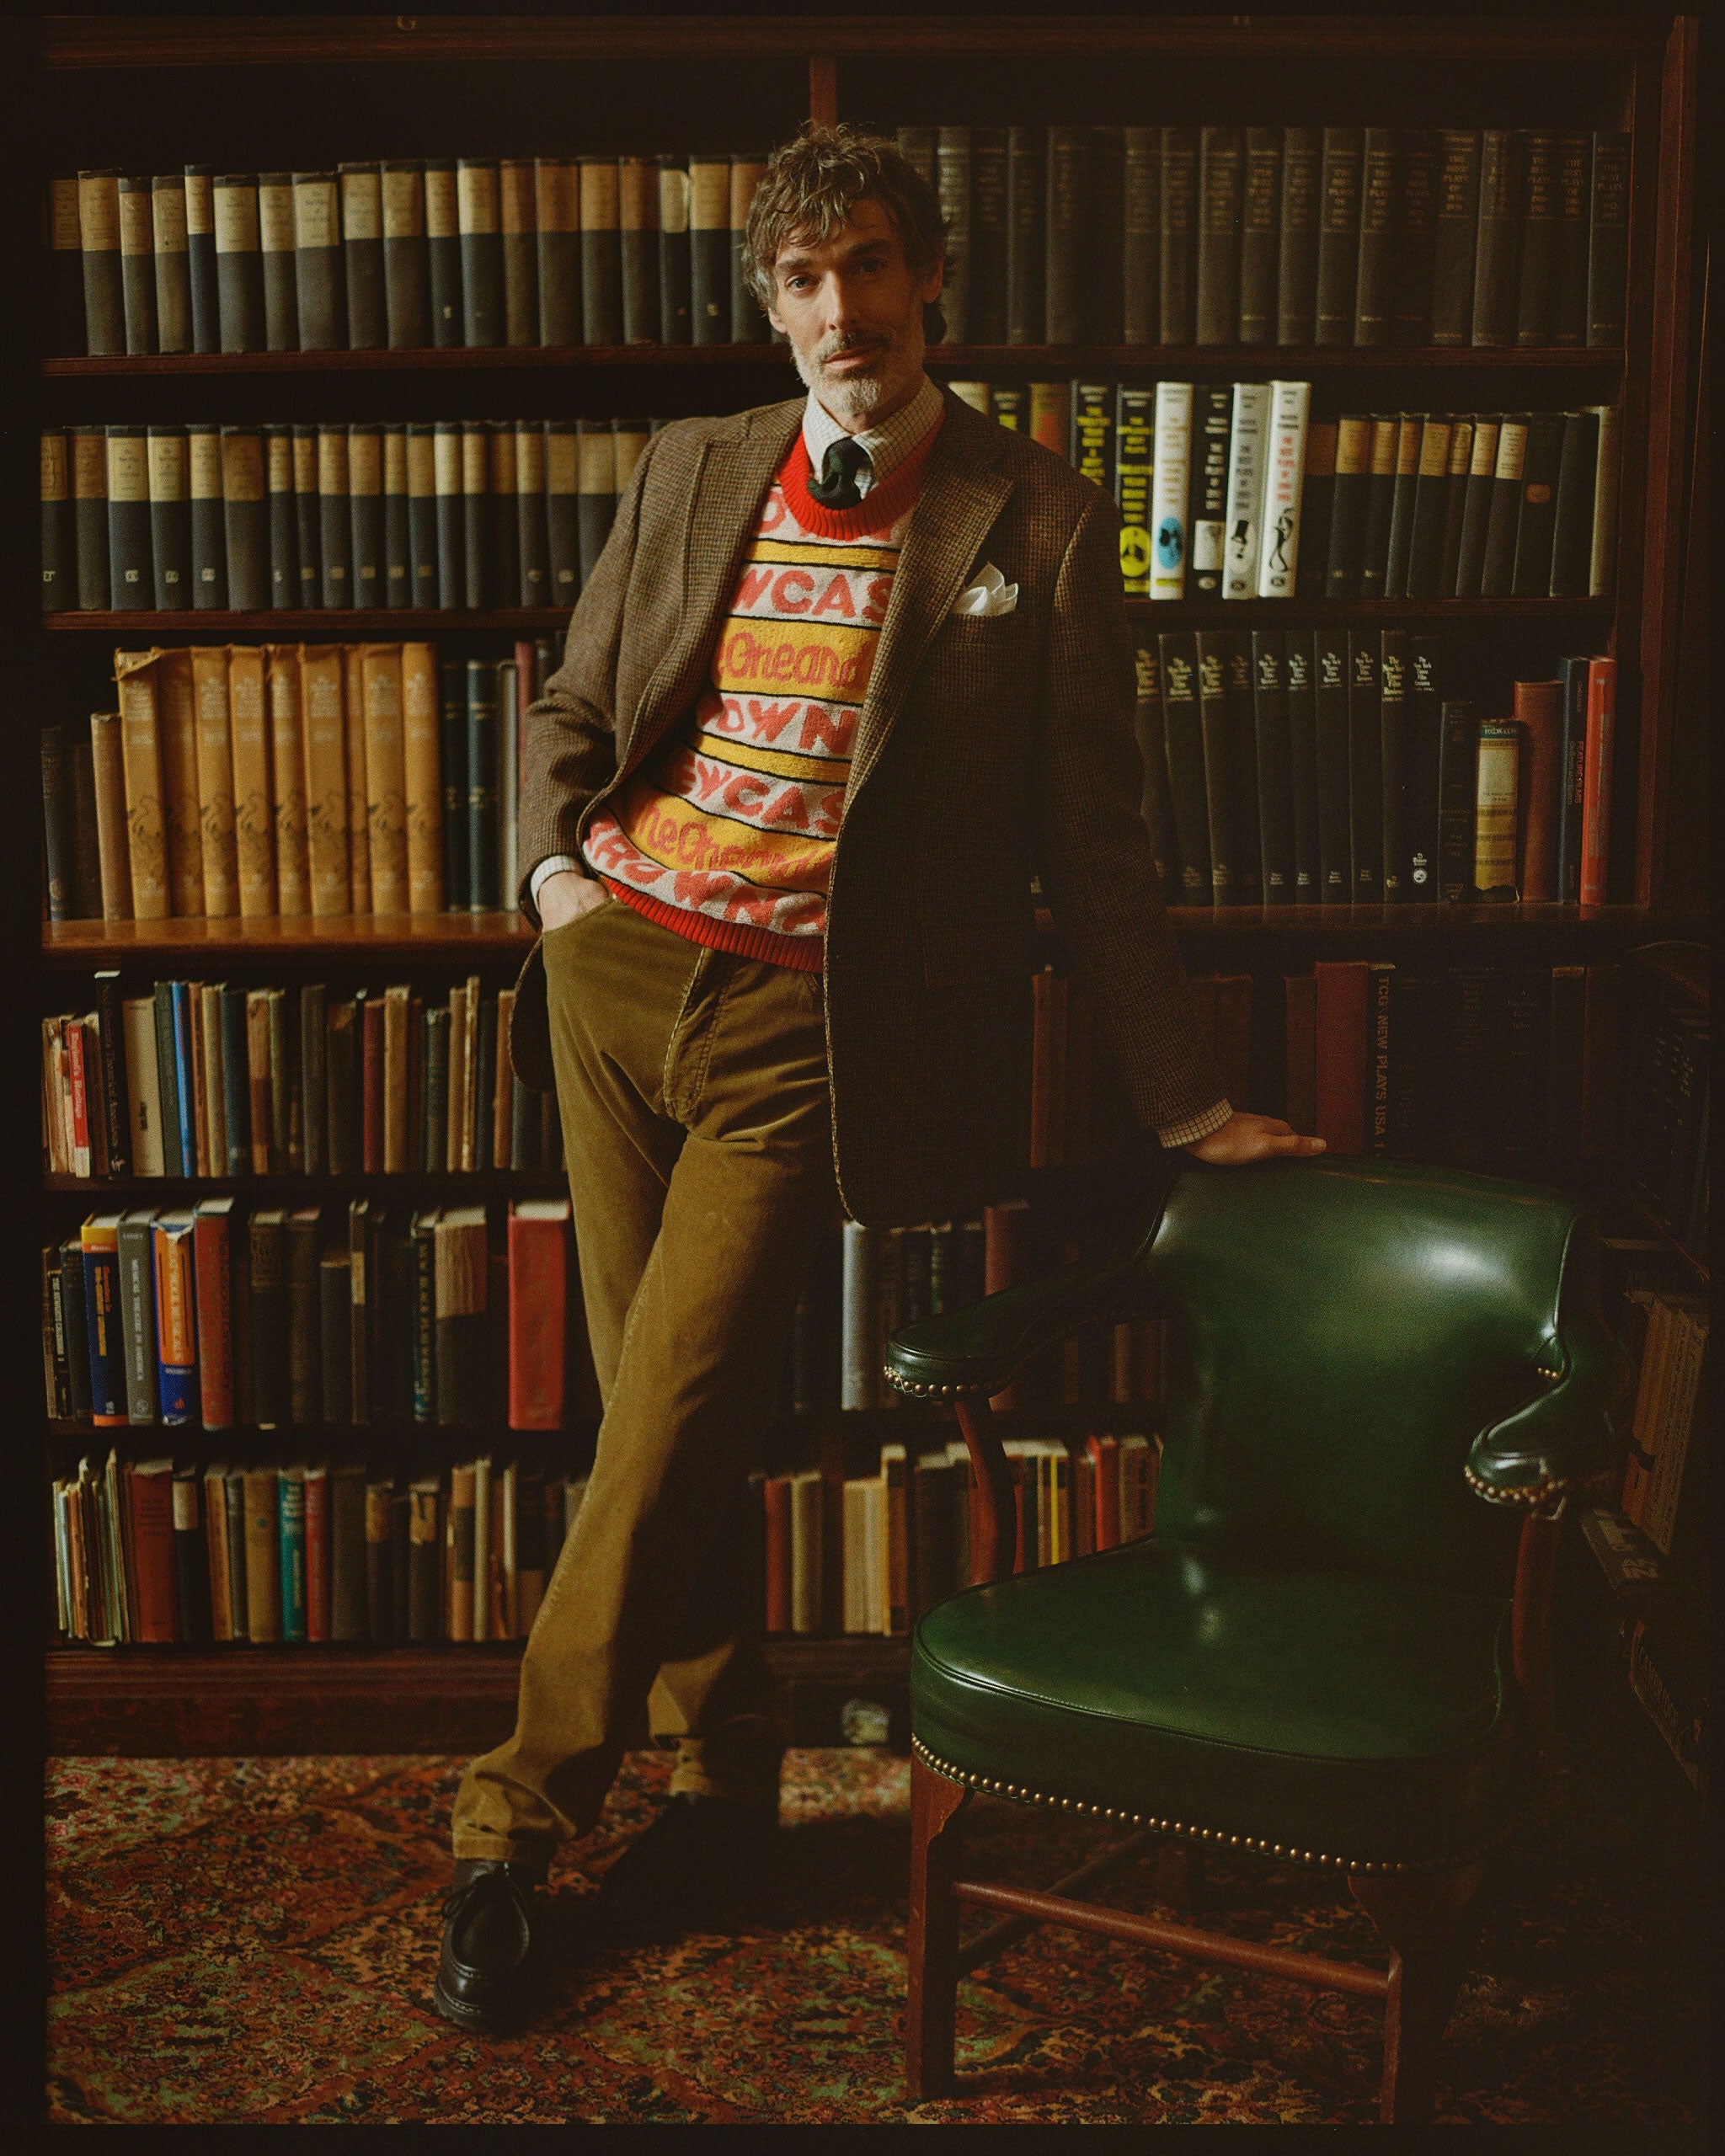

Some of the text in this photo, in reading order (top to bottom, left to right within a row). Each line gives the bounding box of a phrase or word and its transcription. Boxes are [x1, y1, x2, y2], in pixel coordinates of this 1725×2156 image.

[1378, 976, 1390, 1006] TCG
[1376, 1014, 1389, 1049] NEW
[1375, 1054, 1388, 1101] PLAYS
[1374, 1105, 1386, 1136] USA
